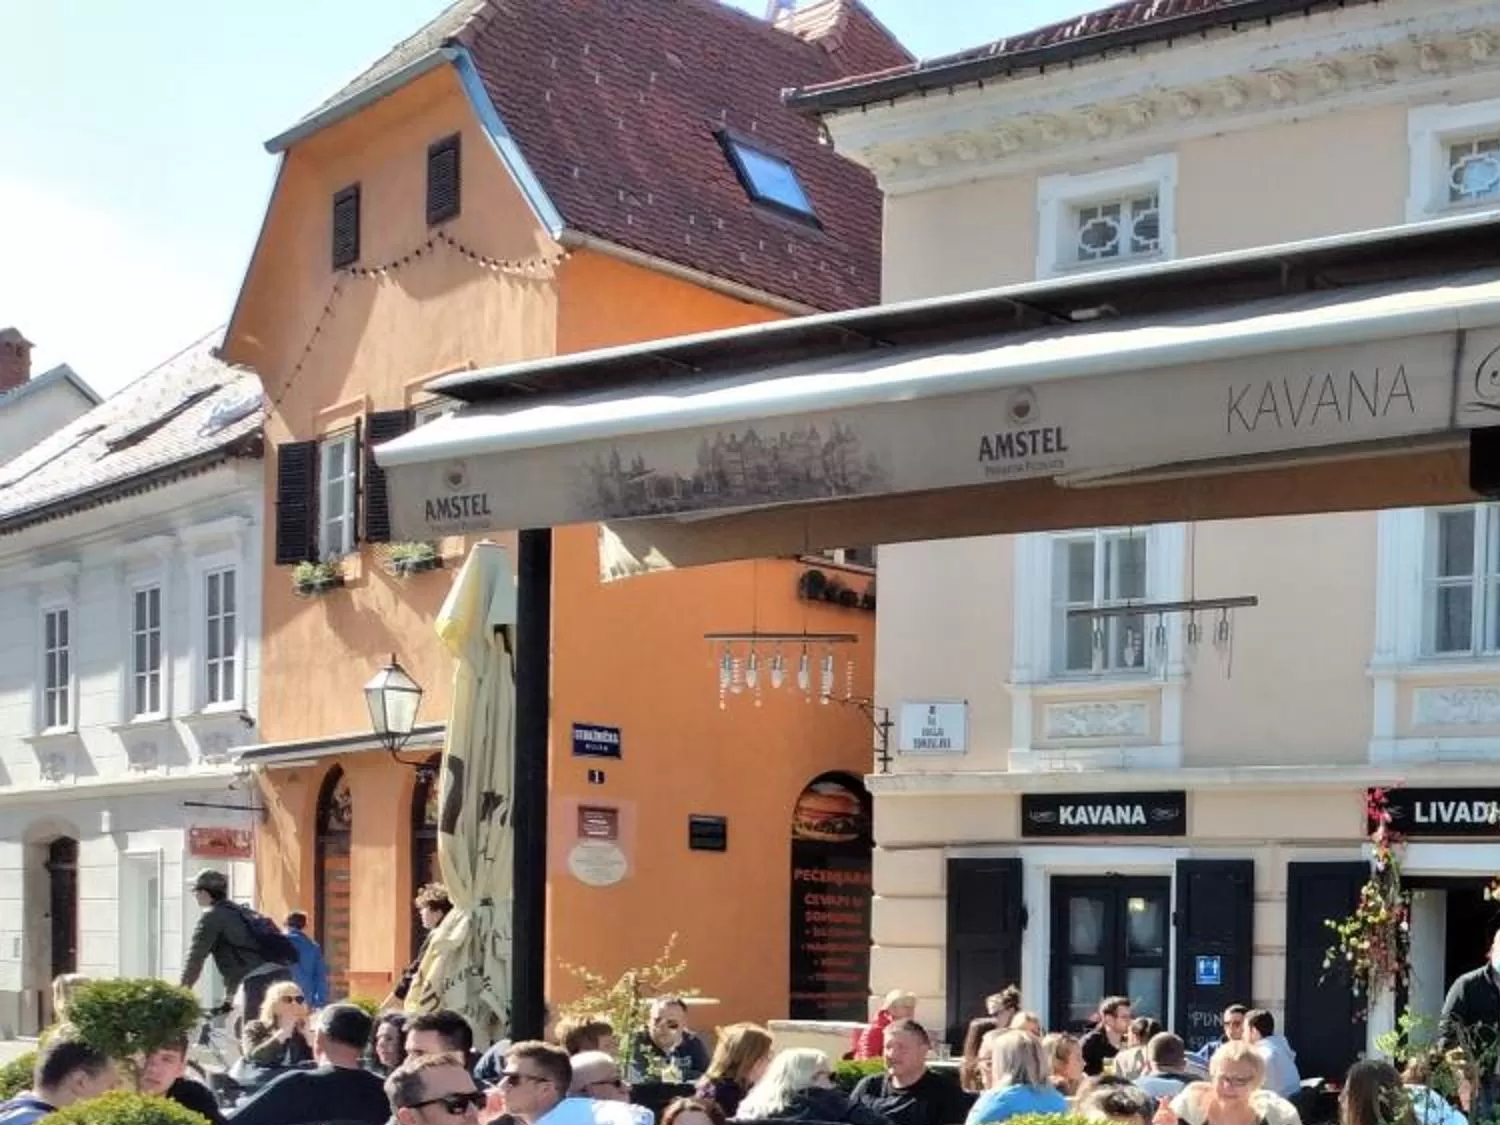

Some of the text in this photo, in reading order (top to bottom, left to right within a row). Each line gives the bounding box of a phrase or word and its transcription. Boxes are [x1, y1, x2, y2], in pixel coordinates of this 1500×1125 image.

[1226, 363, 1415, 434] KAVANA
[978, 426, 1068, 462] AMSTEL
[425, 493, 491, 522] AMSTEL
[1059, 805, 1147, 825] KAVANA
